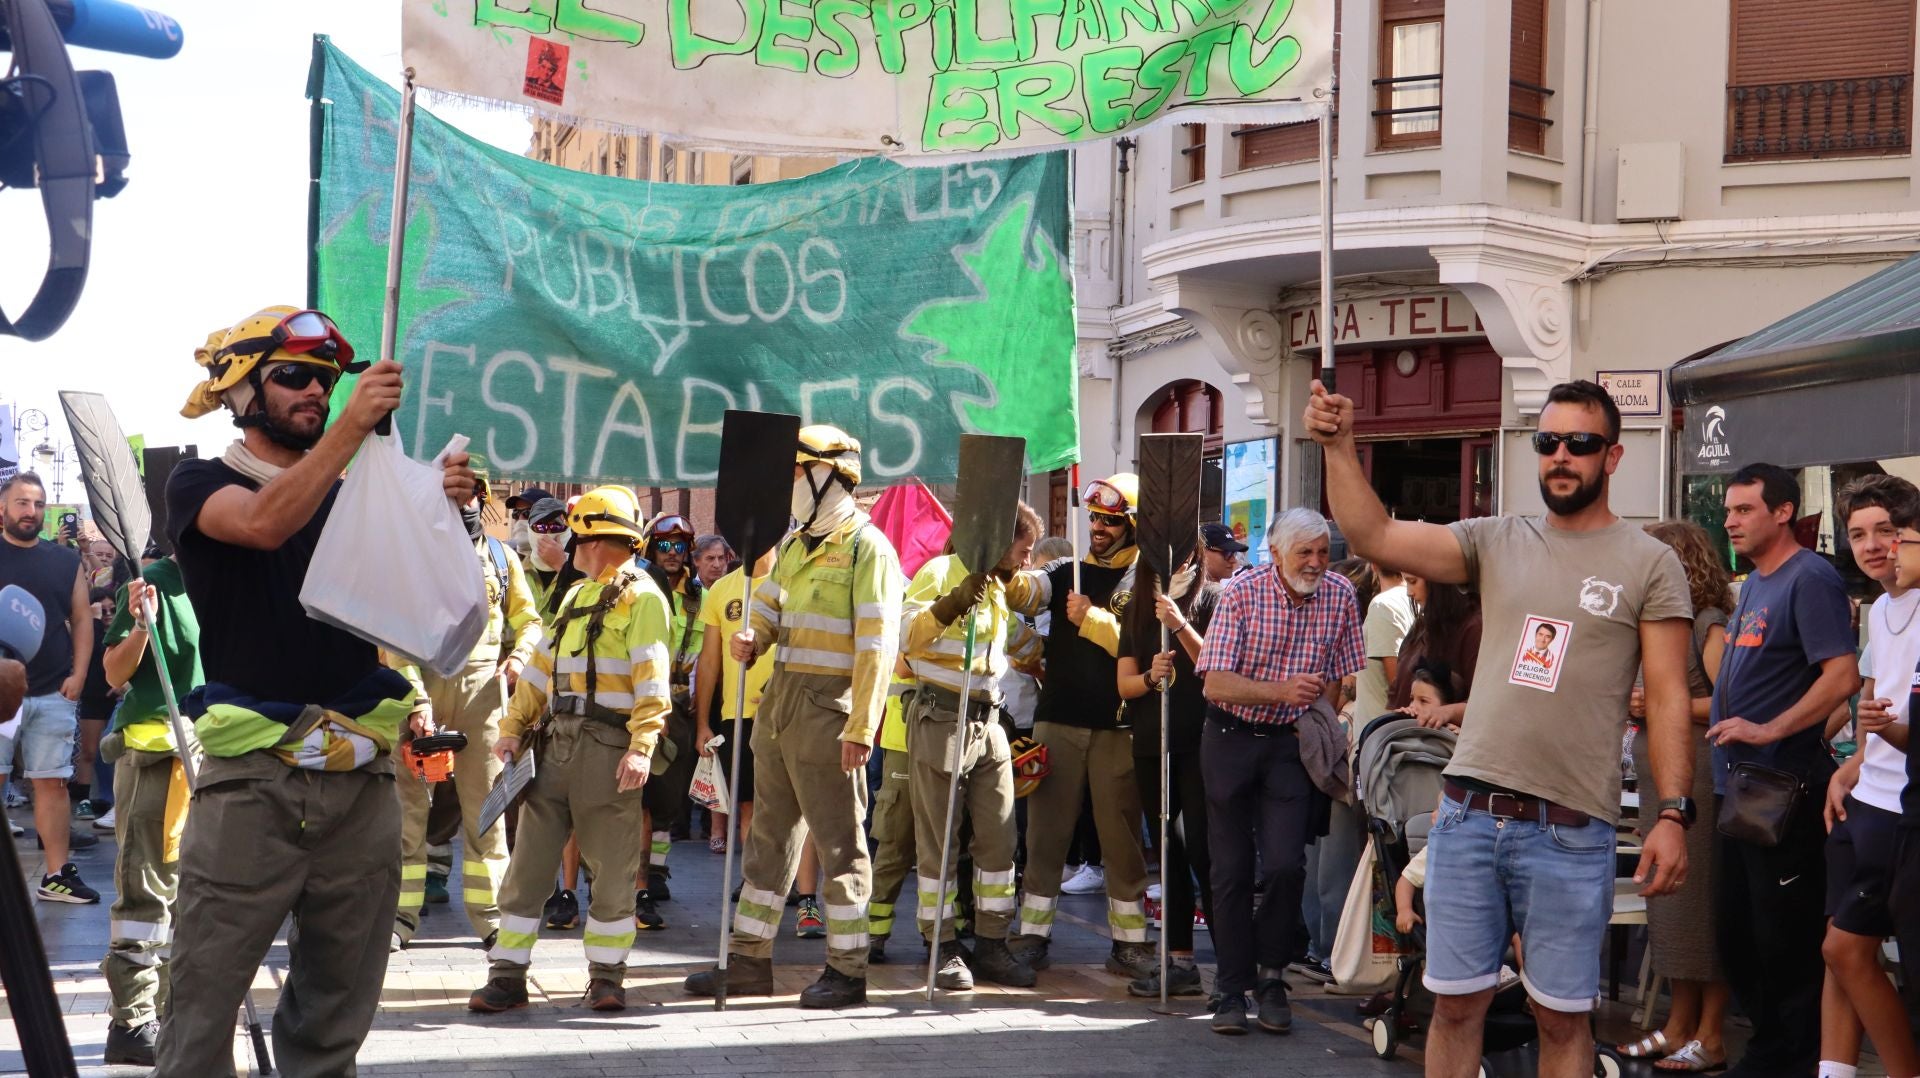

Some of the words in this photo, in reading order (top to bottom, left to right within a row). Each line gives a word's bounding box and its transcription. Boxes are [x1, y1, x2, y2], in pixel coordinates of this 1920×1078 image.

[1616, 379, 1642, 389] CALLE
[9, 597, 42, 632] tve
[1518, 663, 1550, 675] PELIGRO
[1523, 671, 1551, 683] INCENDIO
